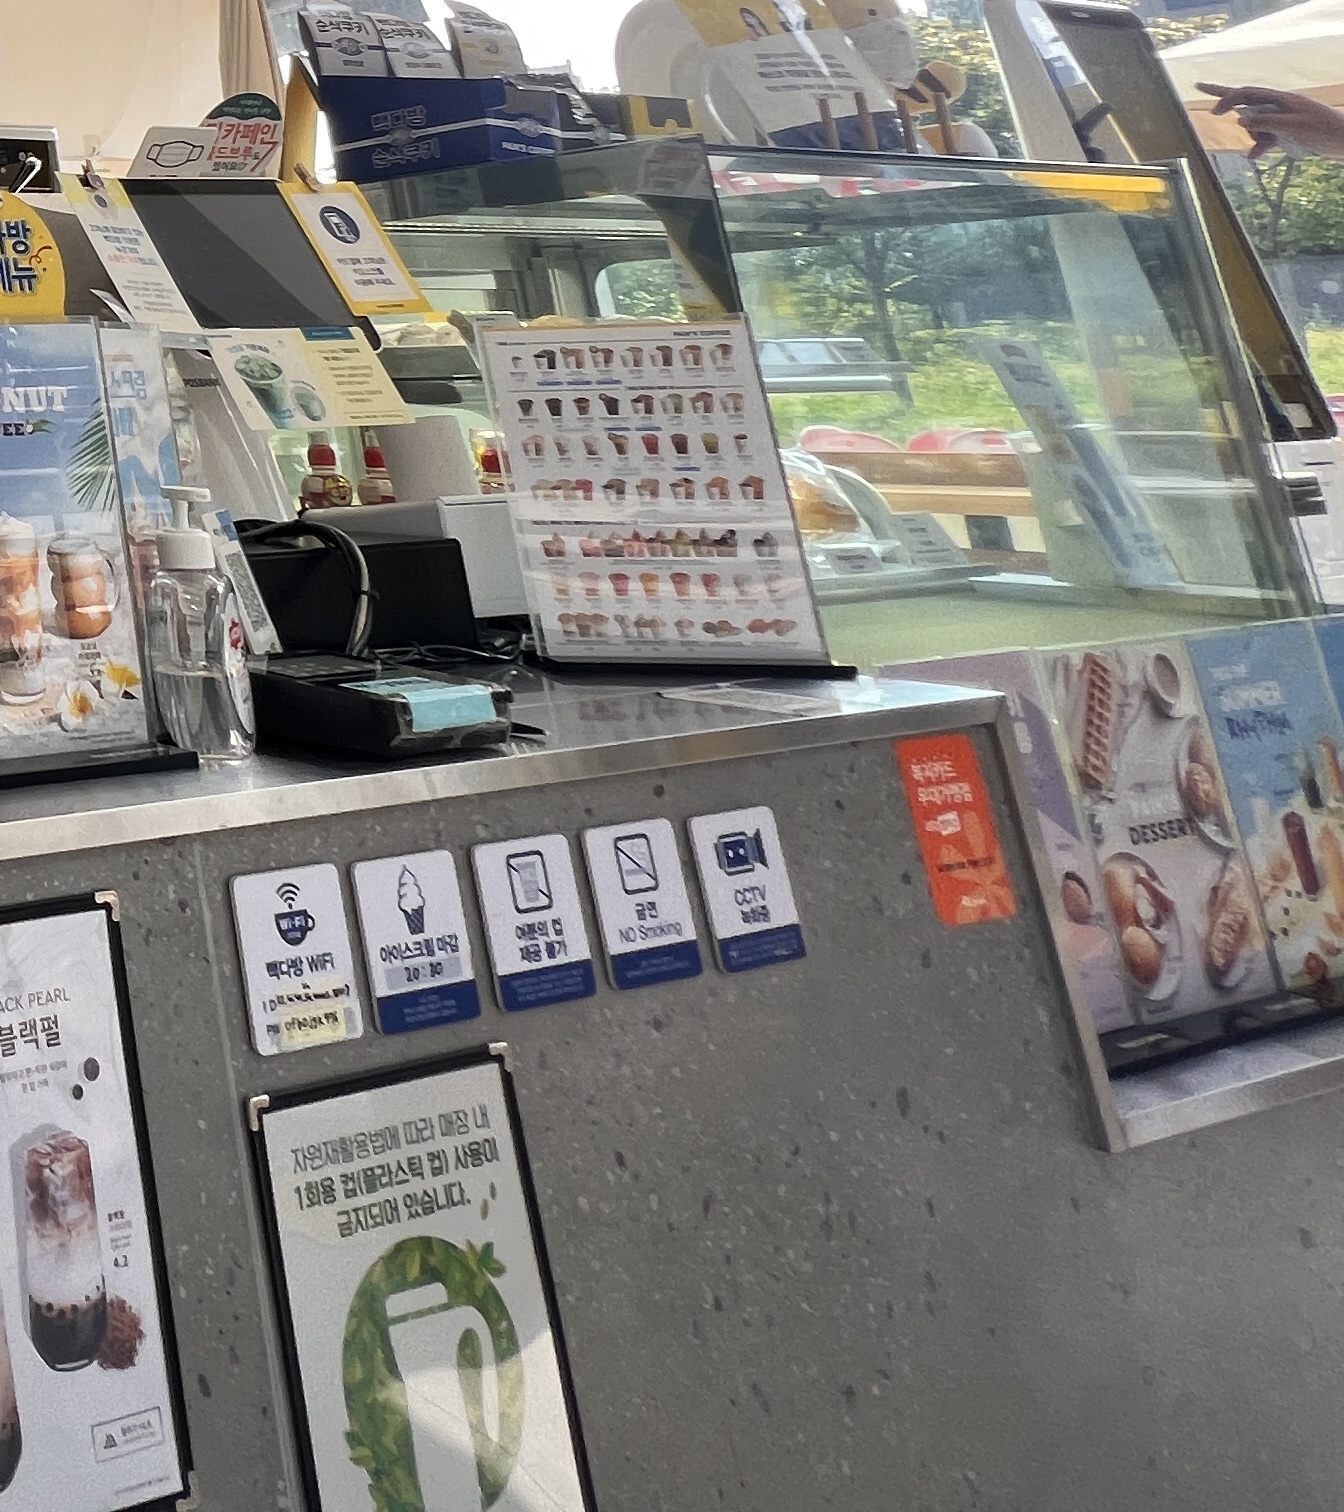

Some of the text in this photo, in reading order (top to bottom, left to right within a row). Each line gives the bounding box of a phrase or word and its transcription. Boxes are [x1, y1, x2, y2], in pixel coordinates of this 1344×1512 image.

[735, 885, 766, 906] CCTV
[380, 937, 435, 965] 아이스크림
[27, 987, 71, 1008] PEARL
[290, 1103, 491, 1174] 자원재활용법에 따라 매장 내
[294, 1137, 500, 1211] 1회용 컵(플라스틱 컵) 사용이
[336, 1182, 472, 1238] 금지되어 있습니다.
